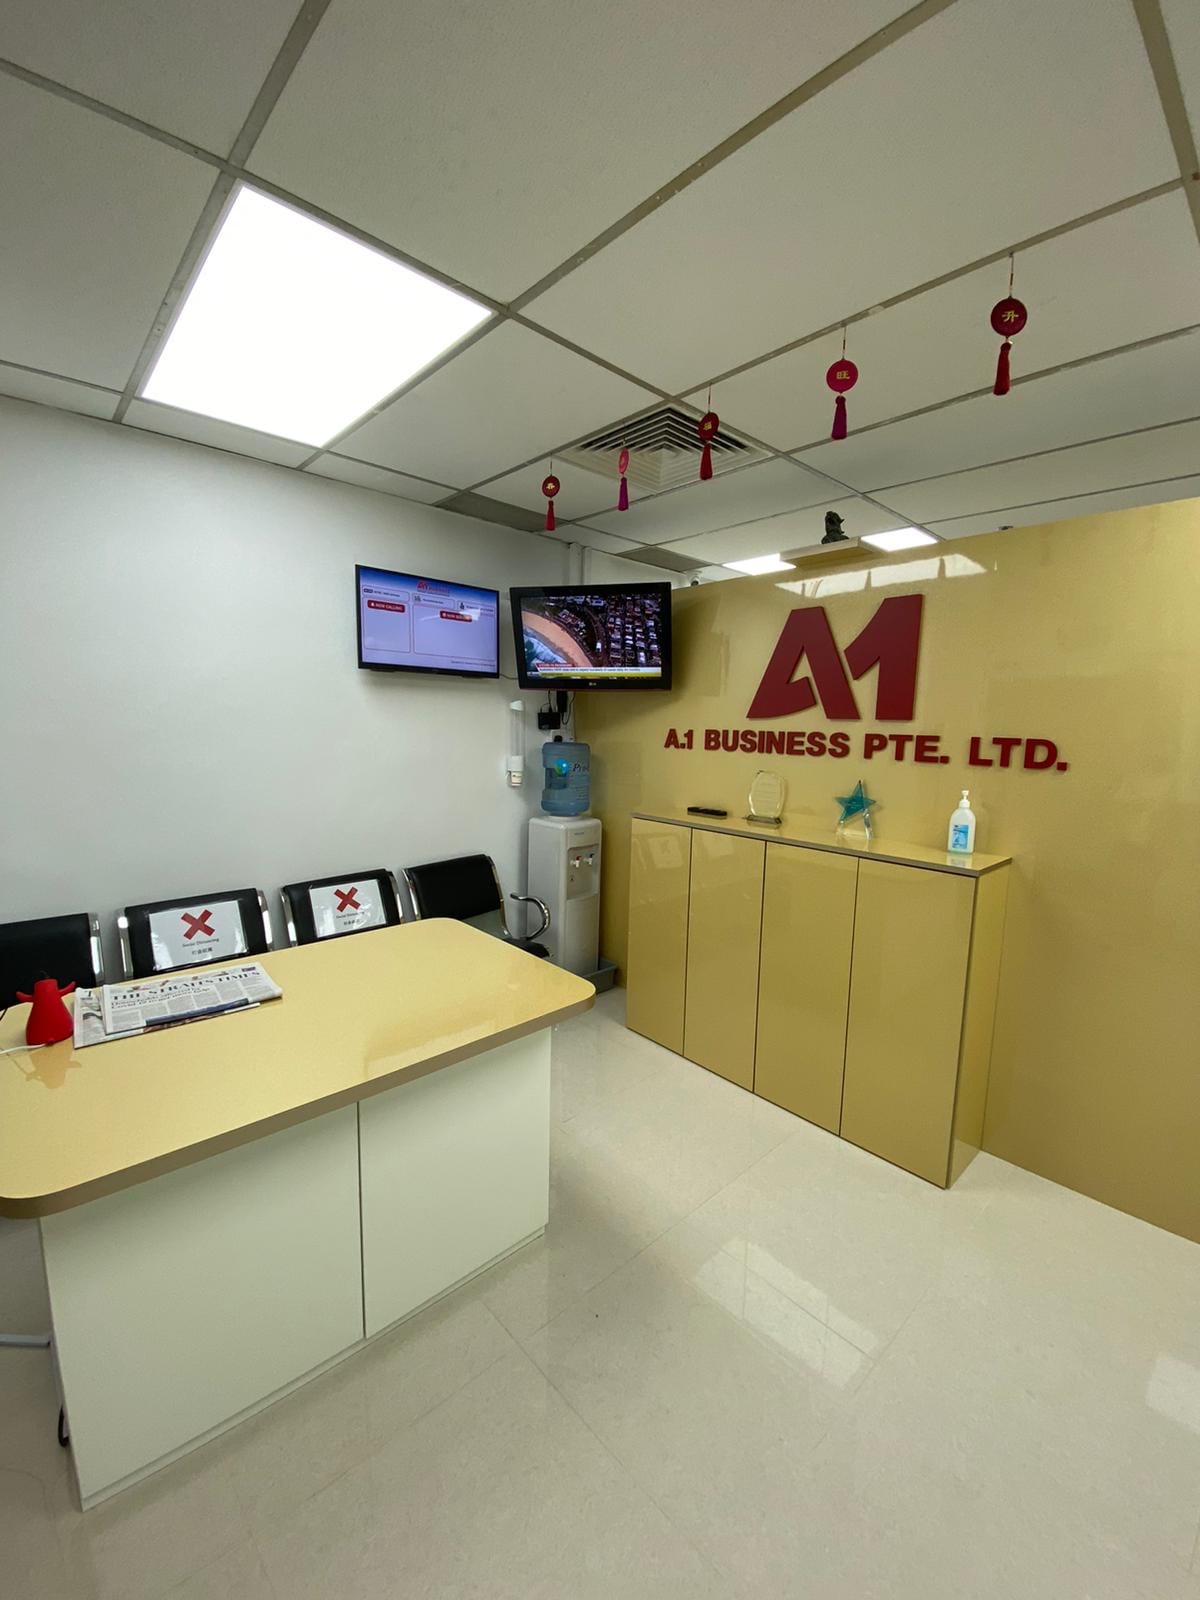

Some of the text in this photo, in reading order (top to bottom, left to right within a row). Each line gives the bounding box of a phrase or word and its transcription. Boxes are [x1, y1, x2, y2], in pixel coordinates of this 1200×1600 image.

[835, 370, 850, 381] 旺
[746, 594, 924, 721] A1
[664, 728, 1069, 772] A.1 BUSINESS PTE. LTD.
[149, 979, 214, 995] STRAITS
[218, 971, 260, 983] TIMES
